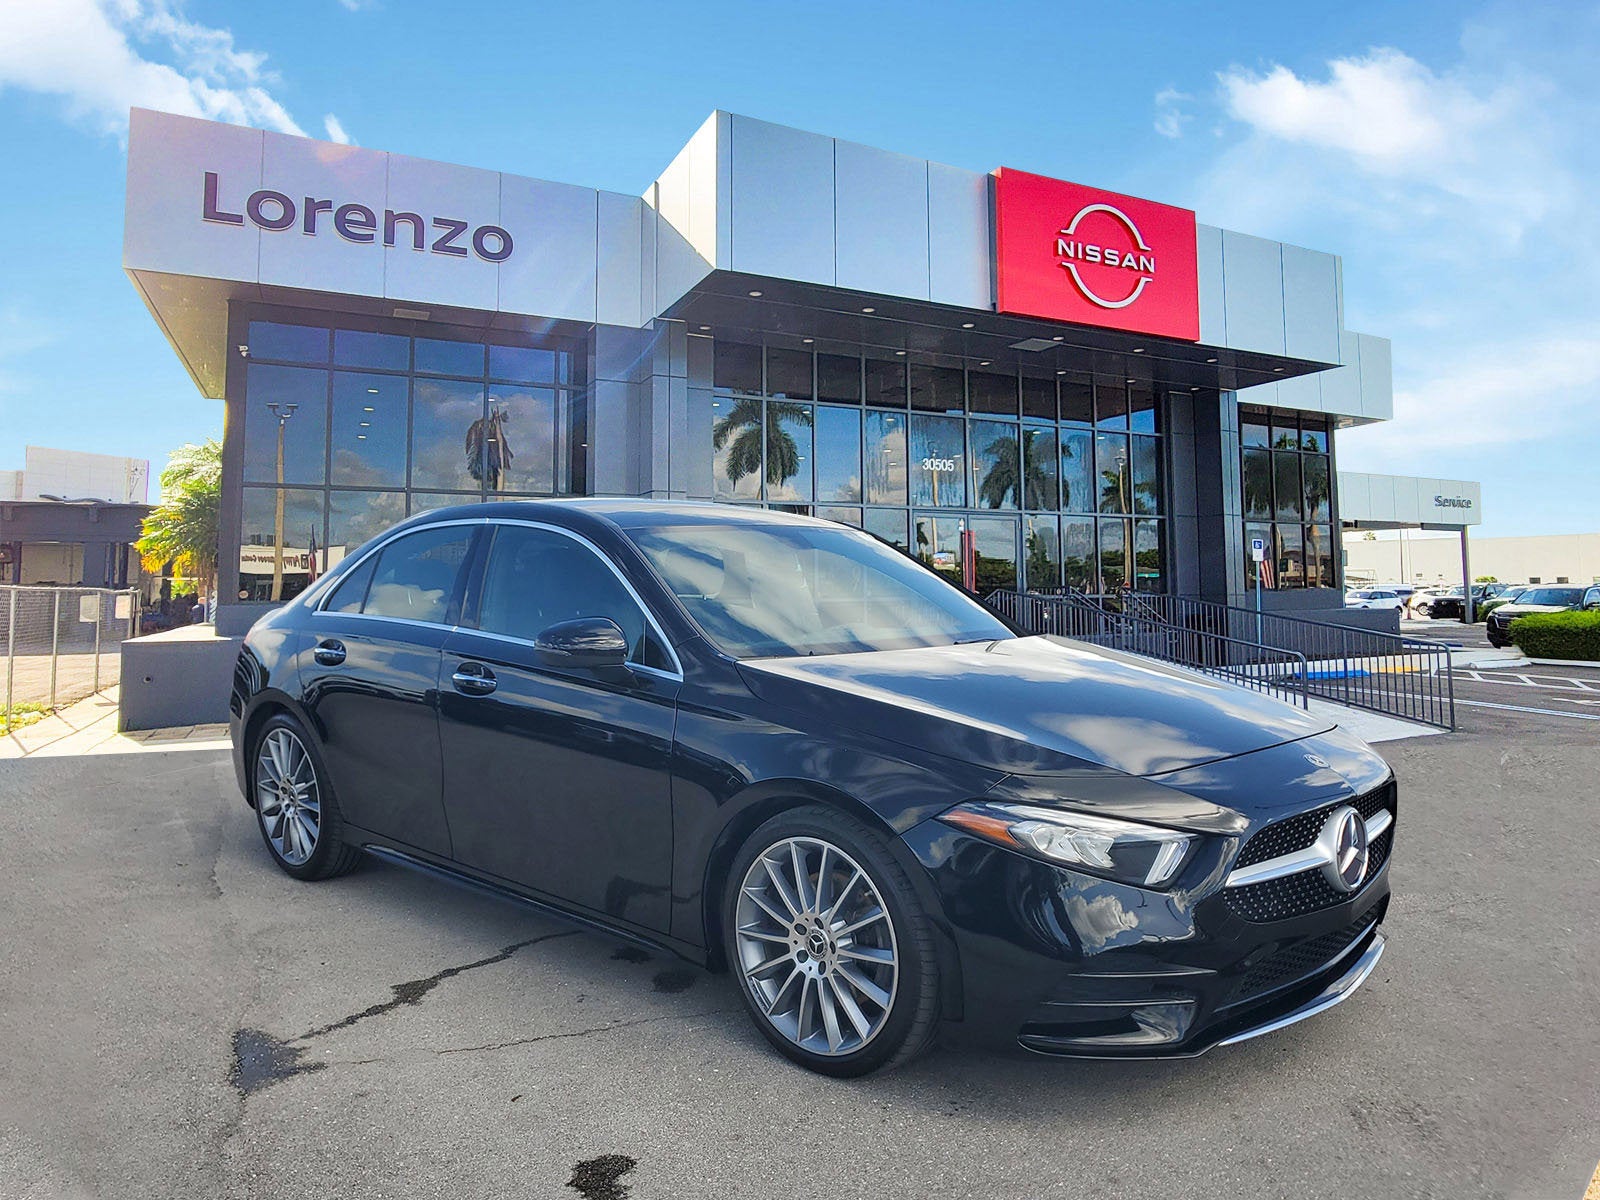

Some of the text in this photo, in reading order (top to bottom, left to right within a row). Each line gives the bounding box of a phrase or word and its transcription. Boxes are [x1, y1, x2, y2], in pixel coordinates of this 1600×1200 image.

[203, 171, 514, 262] Lorenzo
[1057, 238, 1155, 273] NISSAN
[922, 457, 955, 472] 30505
[1434, 495, 1472, 509] Service
